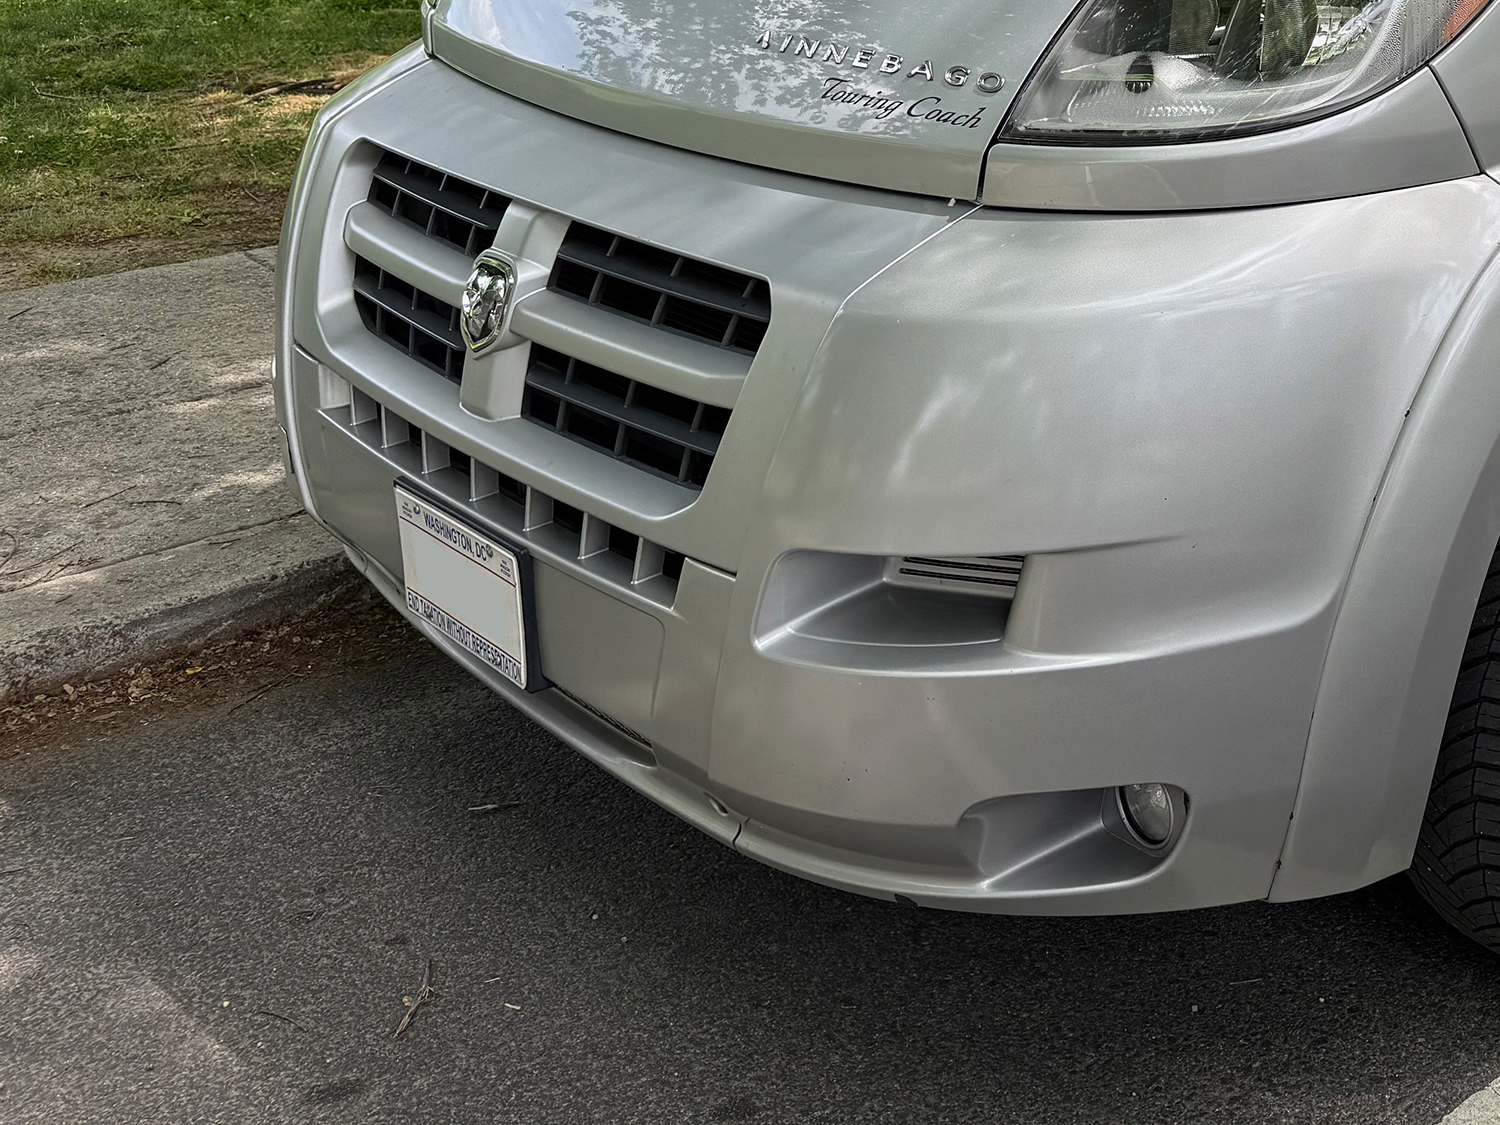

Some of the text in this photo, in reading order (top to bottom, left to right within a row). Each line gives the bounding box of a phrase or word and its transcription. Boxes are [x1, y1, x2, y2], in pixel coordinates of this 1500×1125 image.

[821, 76, 989, 129] Touring Coach
[475, 541, 487, 562] DC
[408, 591, 420, 612] END
[420, 599, 446, 632] TAATION
[472, 633, 522, 684] REPRESETATION
